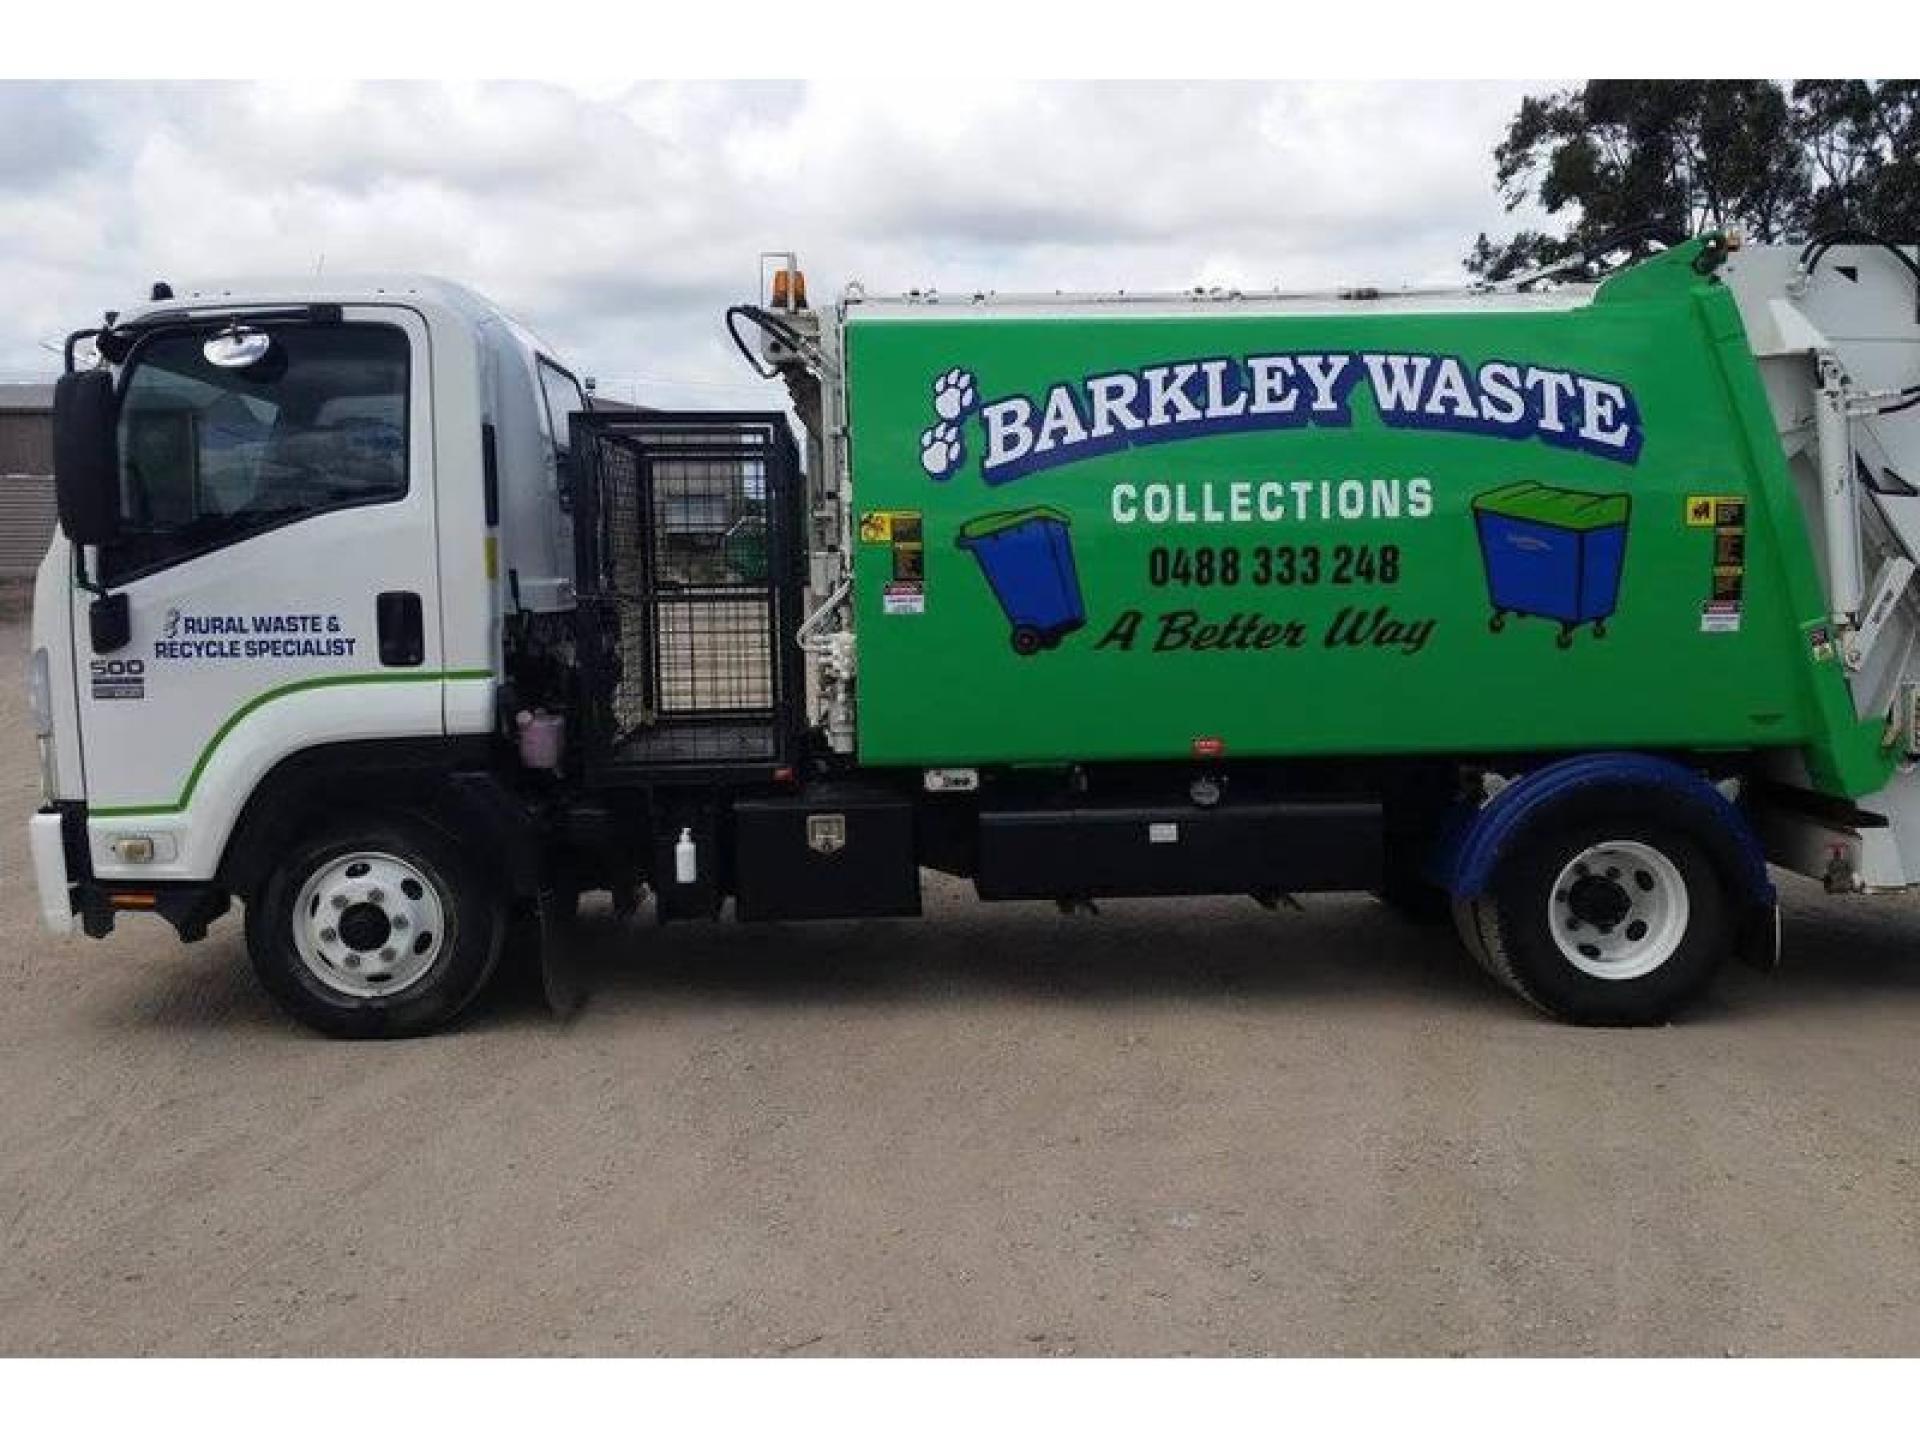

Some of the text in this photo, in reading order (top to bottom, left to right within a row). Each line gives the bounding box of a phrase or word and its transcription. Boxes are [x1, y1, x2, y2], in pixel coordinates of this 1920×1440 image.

[982, 354, 1630, 469] BARKLEY WASTE
[1111, 478, 1434, 525] COLLECTIONS
[1149, 544, 1400, 587] 0488 333 248
[184, 614, 341, 634] RURAL WASTE &
[1094, 606, 1438, 655] A Better Way
[90, 659, 145, 675] 500
[154, 638, 356, 659] RECYCLE SPECIALIST
